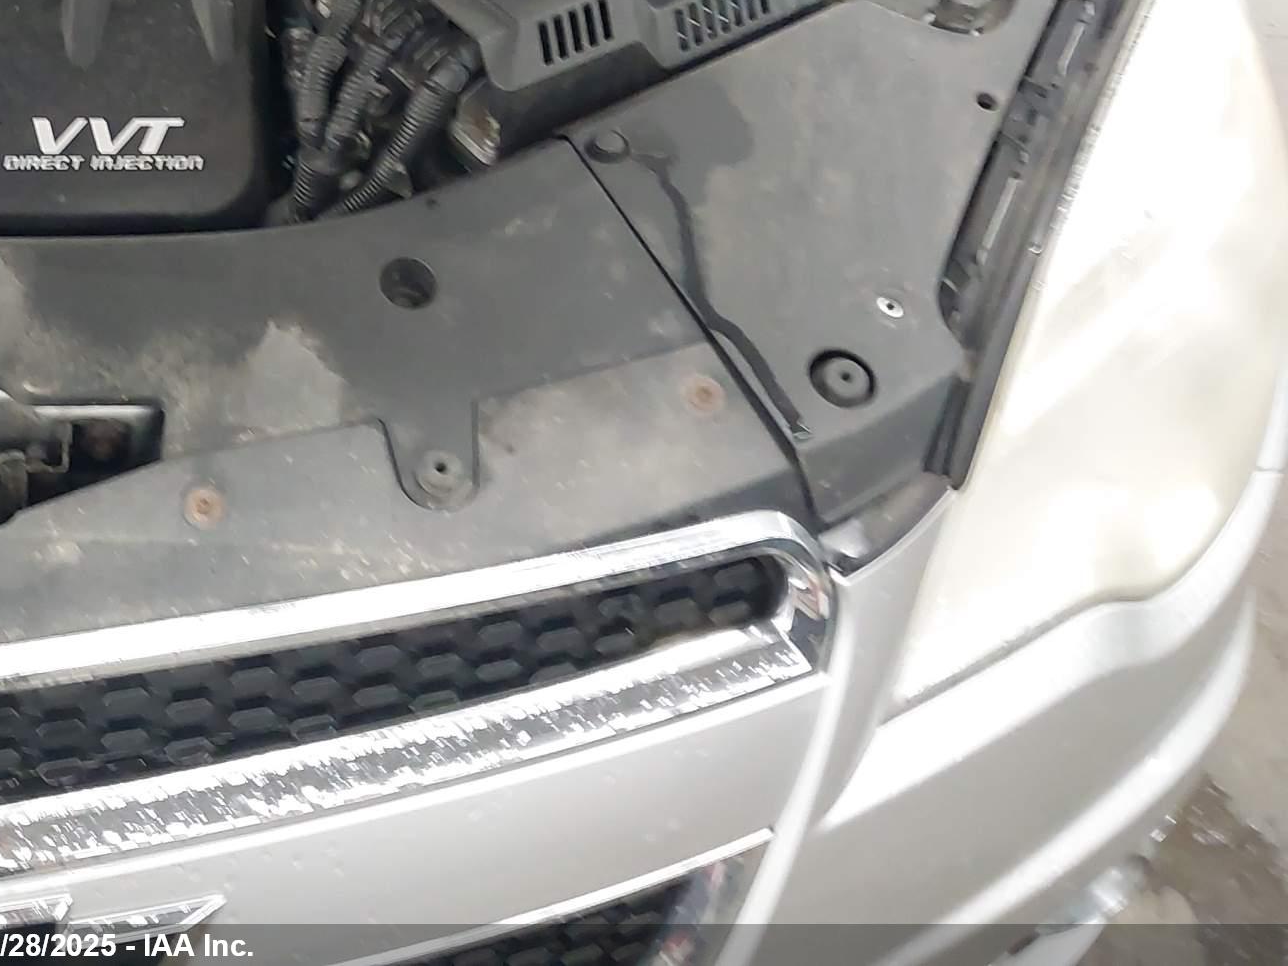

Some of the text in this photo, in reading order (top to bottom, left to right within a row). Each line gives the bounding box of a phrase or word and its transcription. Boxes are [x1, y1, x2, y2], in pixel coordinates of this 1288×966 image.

[32, 117, 185, 155] VVT
[3, 154, 204, 171] DIRECT INJECTION
